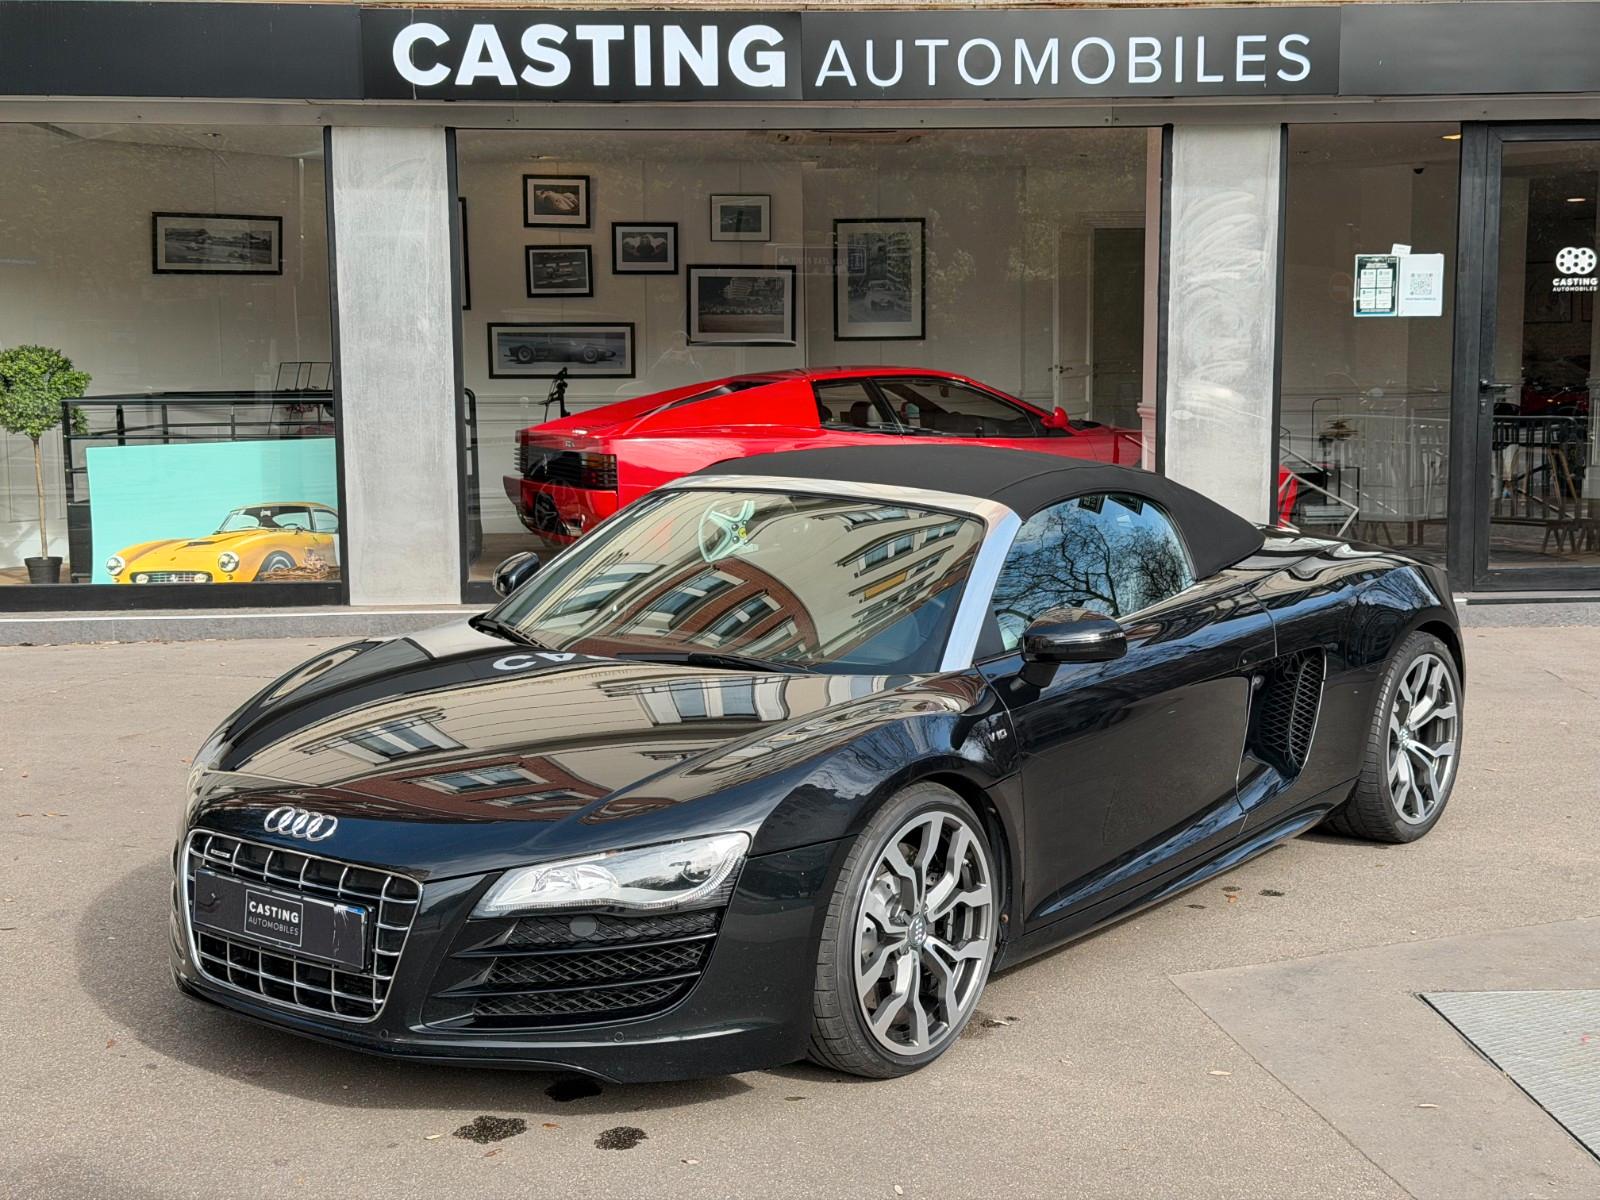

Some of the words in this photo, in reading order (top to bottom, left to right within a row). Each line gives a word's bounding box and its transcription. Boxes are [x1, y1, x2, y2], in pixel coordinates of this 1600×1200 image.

[392, 22, 787, 88] CASTING
[814, 33, 1313, 88] AUTOMOBILES
[1552, 277, 1598, 286] CASTING
[987, 728, 1008, 743] V10
[249, 900, 299, 924] CASTING
[248, 914, 299, 936] AUTOMOBILES
